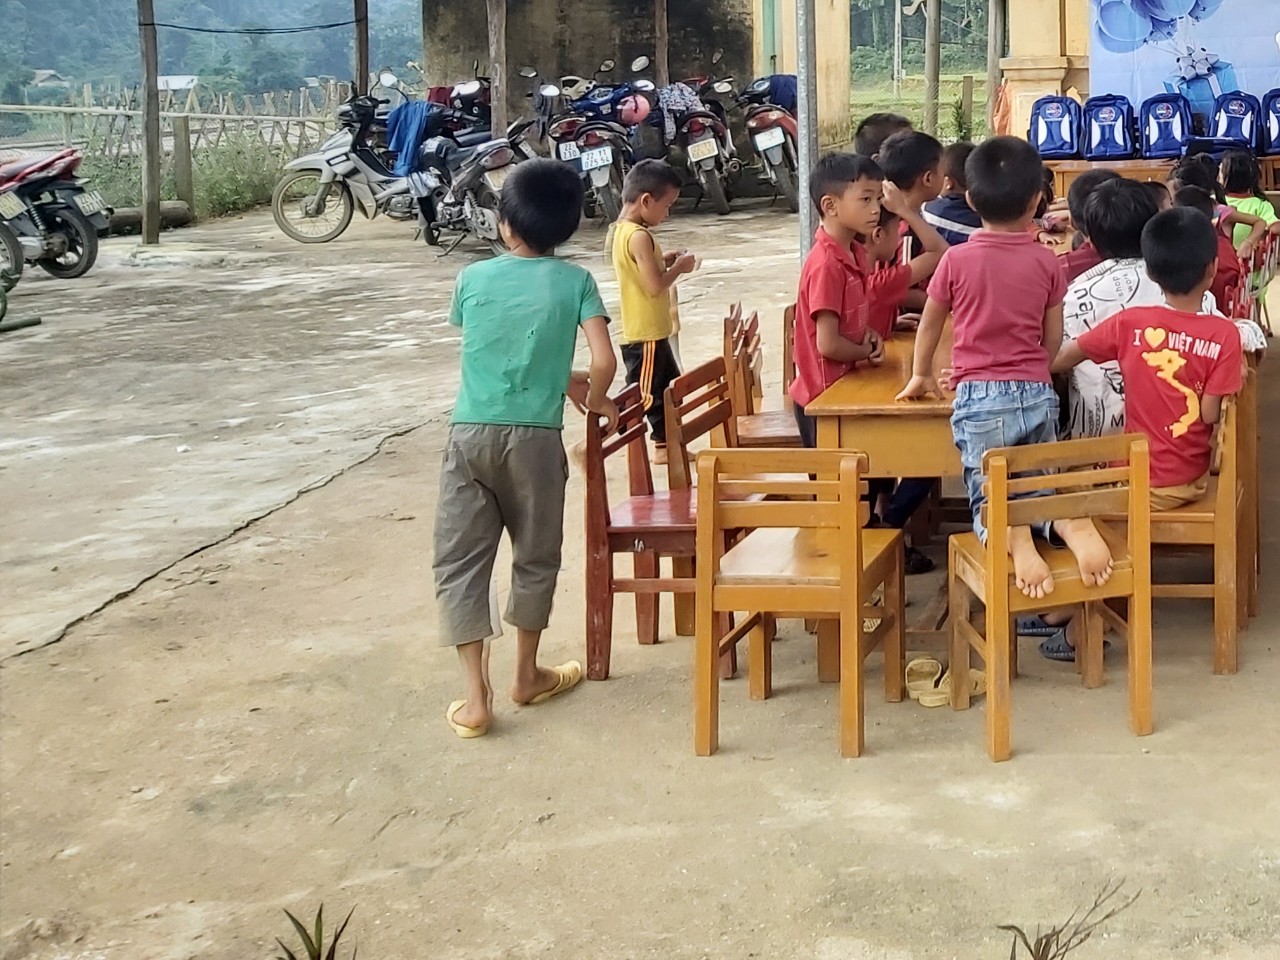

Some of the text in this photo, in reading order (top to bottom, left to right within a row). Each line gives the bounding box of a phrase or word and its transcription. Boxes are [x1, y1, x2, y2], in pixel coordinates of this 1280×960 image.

[1133, 329, 1222, 360] I VIỆT NAM
